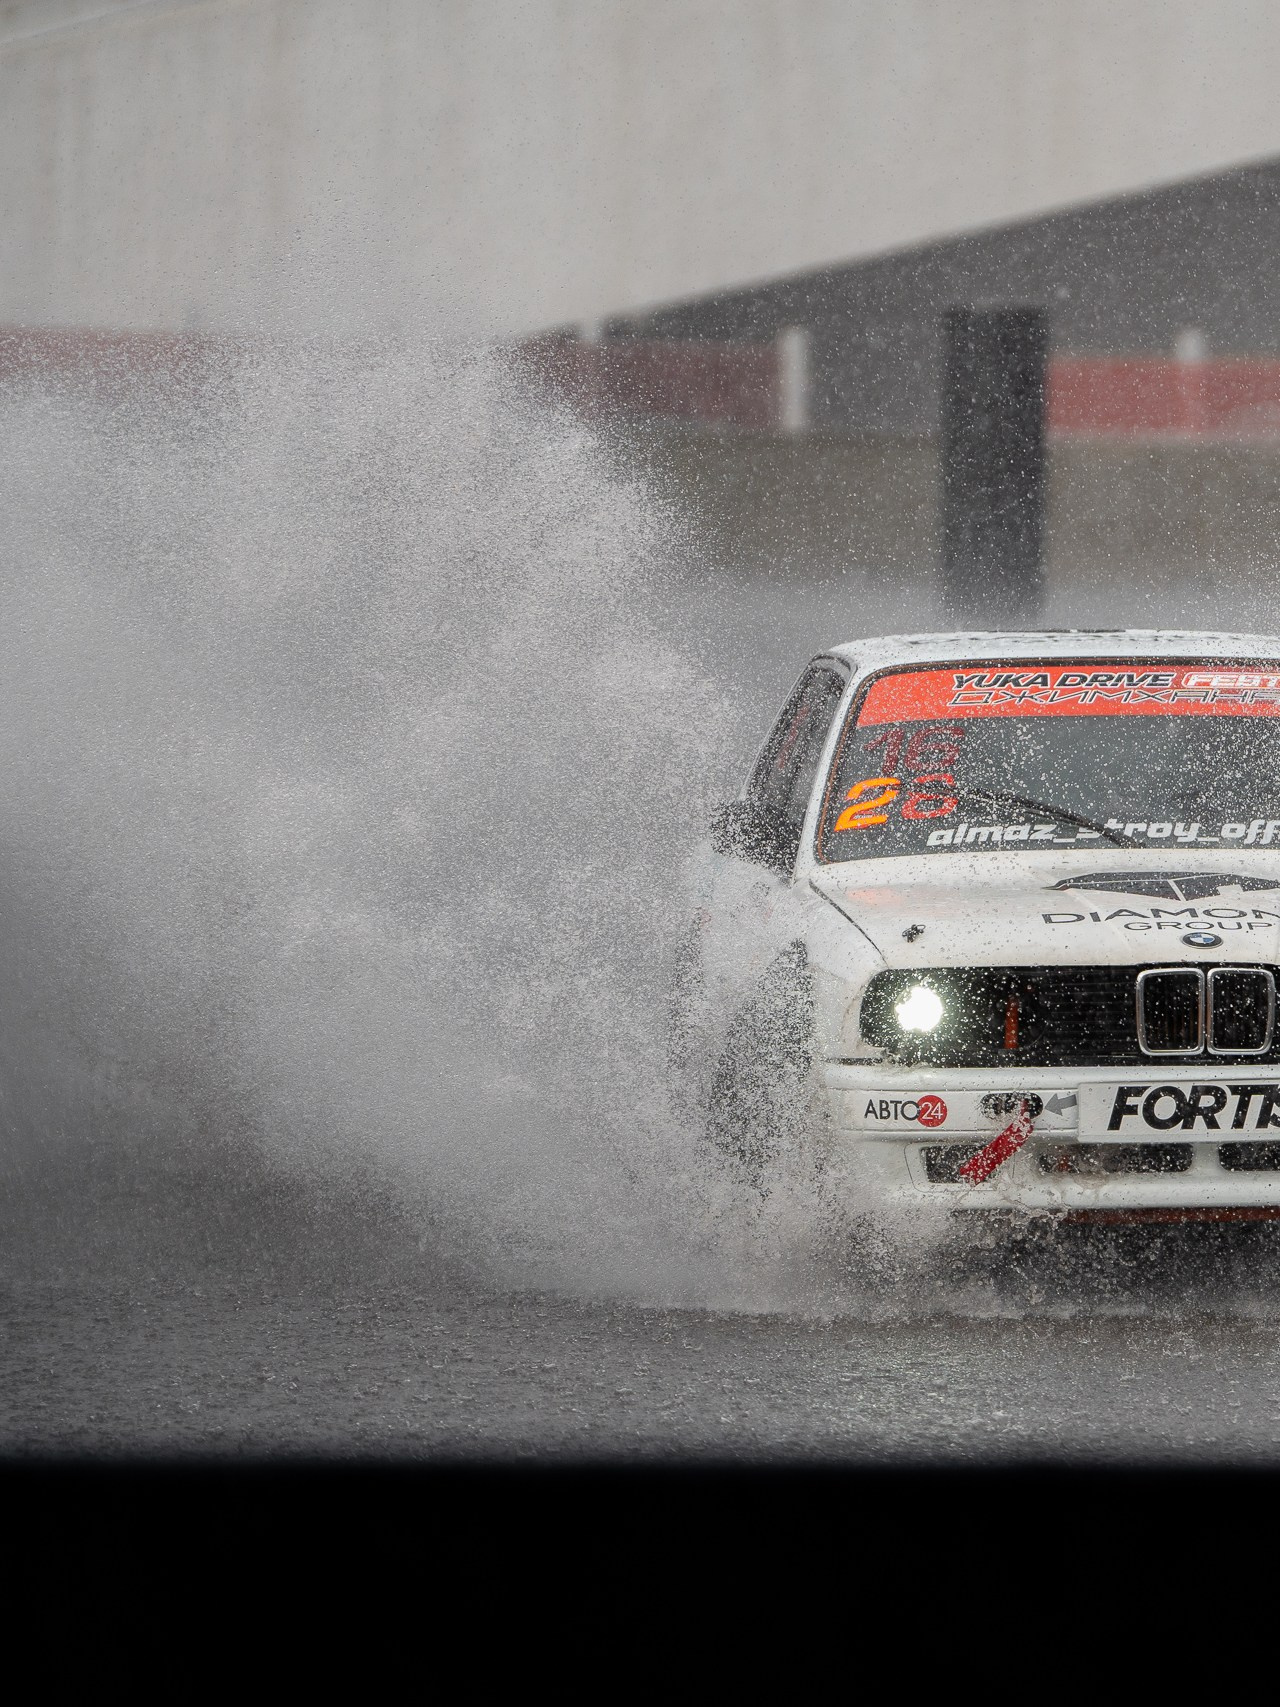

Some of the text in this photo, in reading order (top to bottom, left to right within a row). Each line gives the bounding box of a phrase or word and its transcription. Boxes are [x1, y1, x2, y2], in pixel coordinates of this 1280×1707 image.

[952, 672, 1050, 690] YUKA
[1054, 671, 1177, 689] DRIVE
[1124, 921, 1273, 930] GROUP
